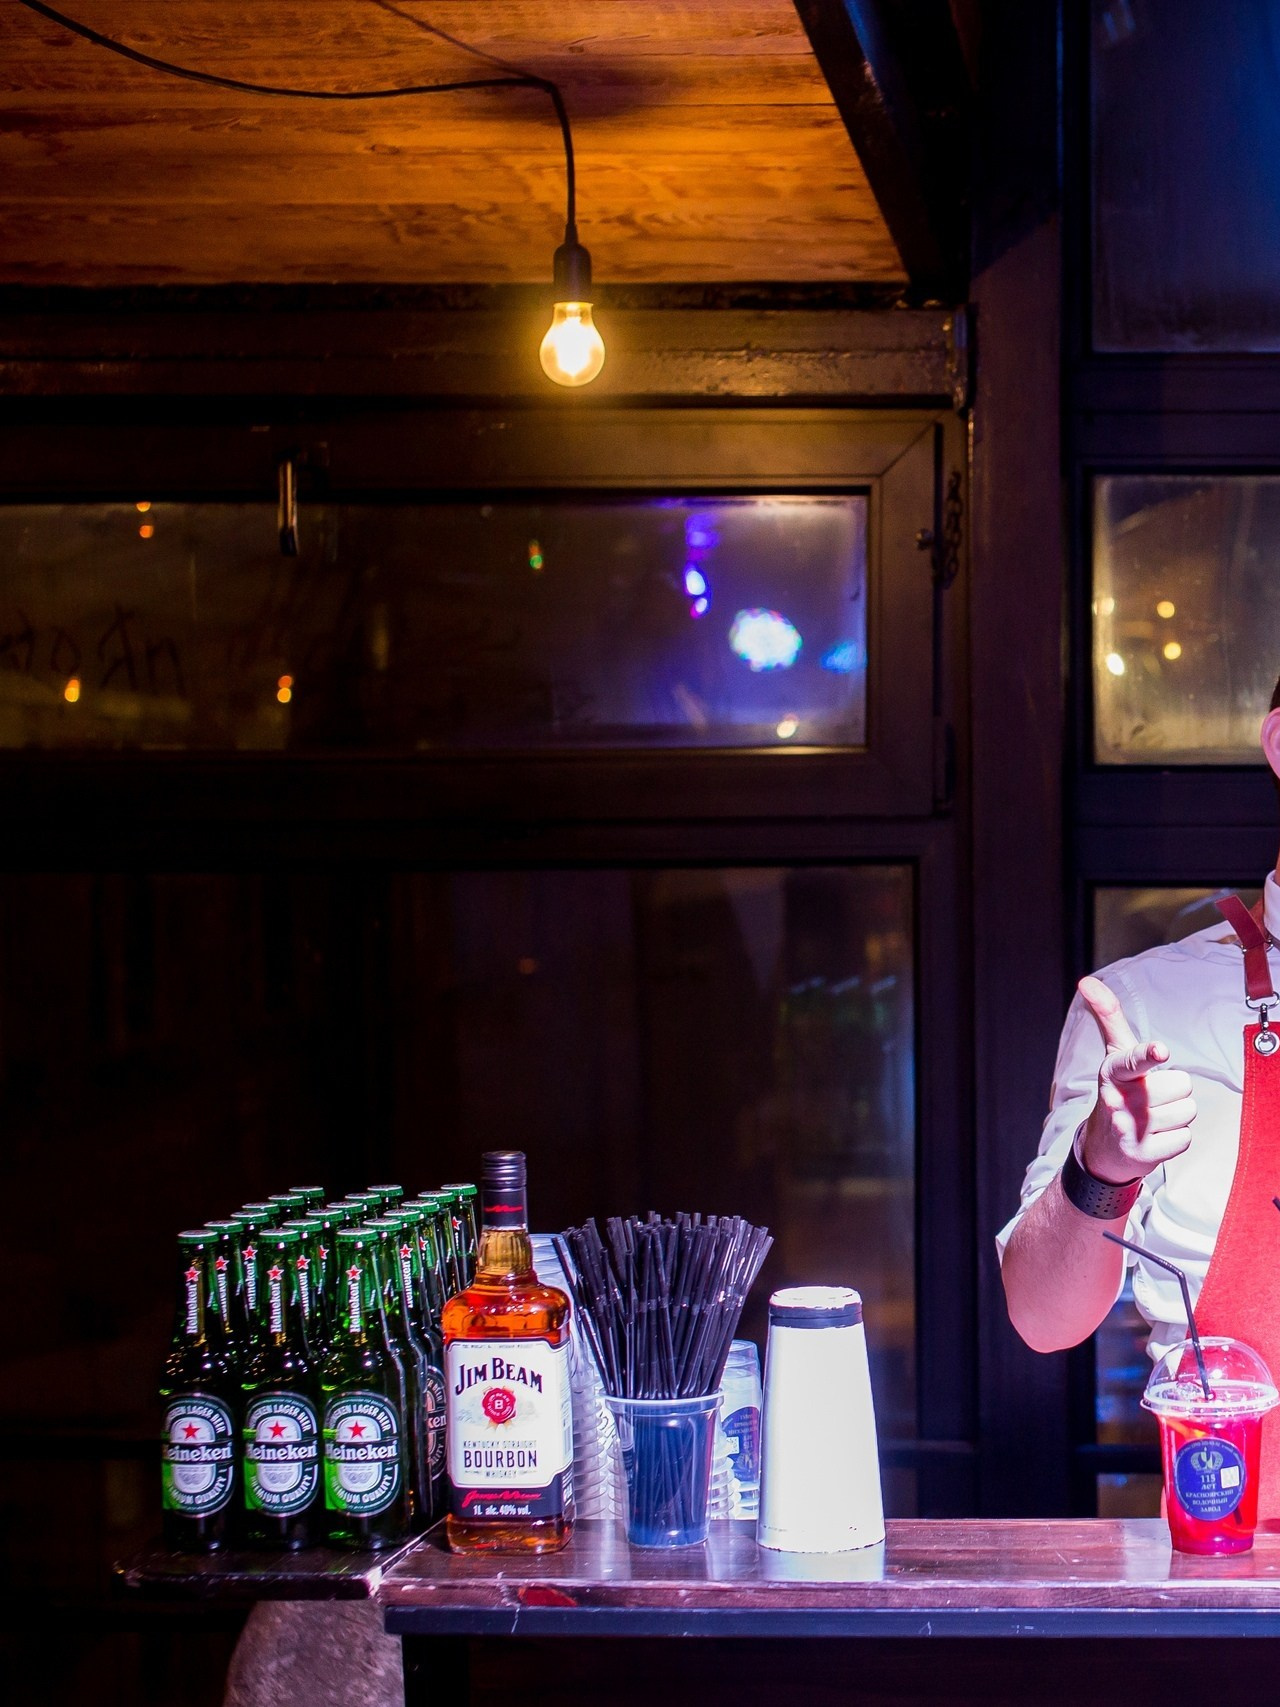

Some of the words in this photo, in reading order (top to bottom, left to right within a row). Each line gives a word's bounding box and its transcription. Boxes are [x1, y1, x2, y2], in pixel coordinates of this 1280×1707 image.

[185, 1281, 199, 1335] Heineken
[269, 1281, 282, 1334] Heineken
[348, 1280, 361, 1334] Heineken
[455, 1363, 488, 1396] JIM
[491, 1357, 543, 1394] BEAM
[187, 1405, 214, 1419] LAGER
[210, 1413, 227, 1434] BEER
[273, 1404, 300, 1418] LAGER
[296, 1411, 312, 1432] BEER
[353, 1404, 380, 1418] LAGER
[375, 1411, 392, 1432] BEER
[463, 1450, 538, 1468] BOURBON
[1200, 1474, 1217, 1483] 115
